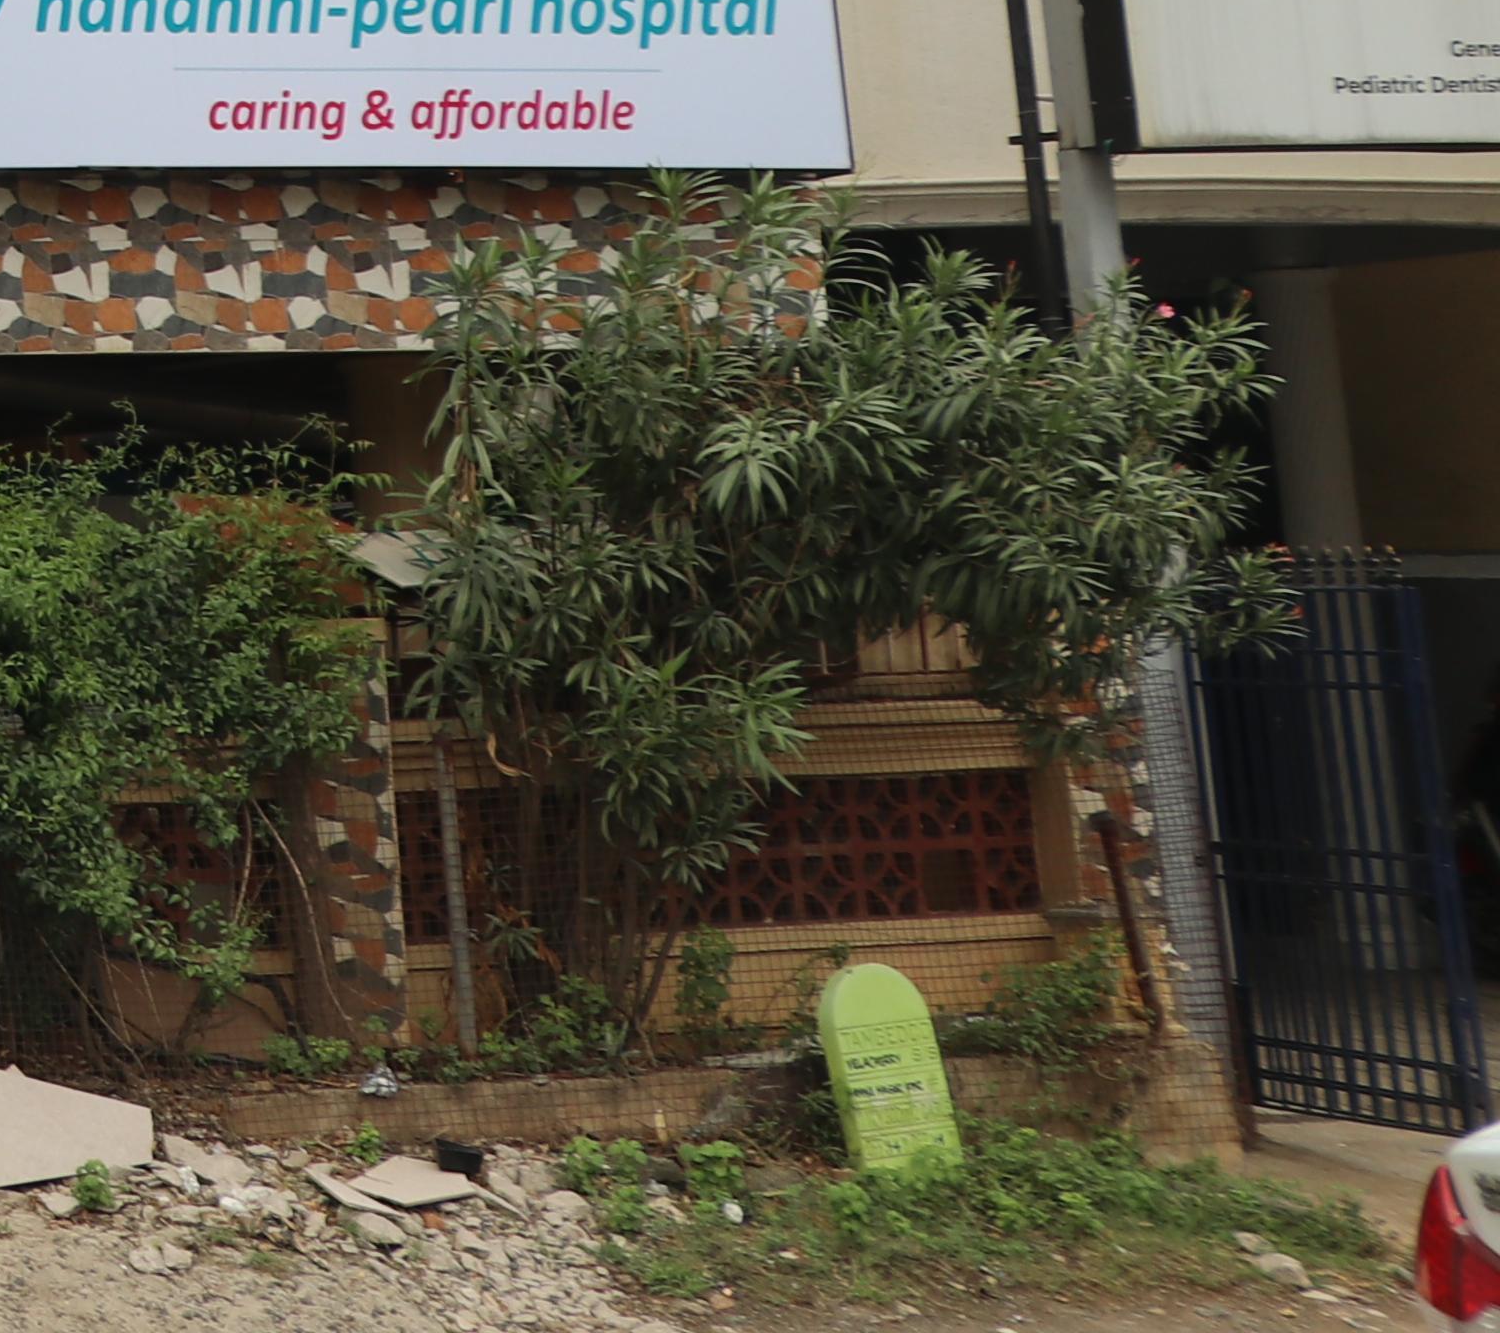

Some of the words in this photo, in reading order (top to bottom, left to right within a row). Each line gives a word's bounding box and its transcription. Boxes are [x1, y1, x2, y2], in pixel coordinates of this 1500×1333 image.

[1334, 74, 1426, 93] Pediatric
[208, 89, 347, 141] caring
[362, 90, 395, 131] &
[410, 89, 636, 141] affordable
